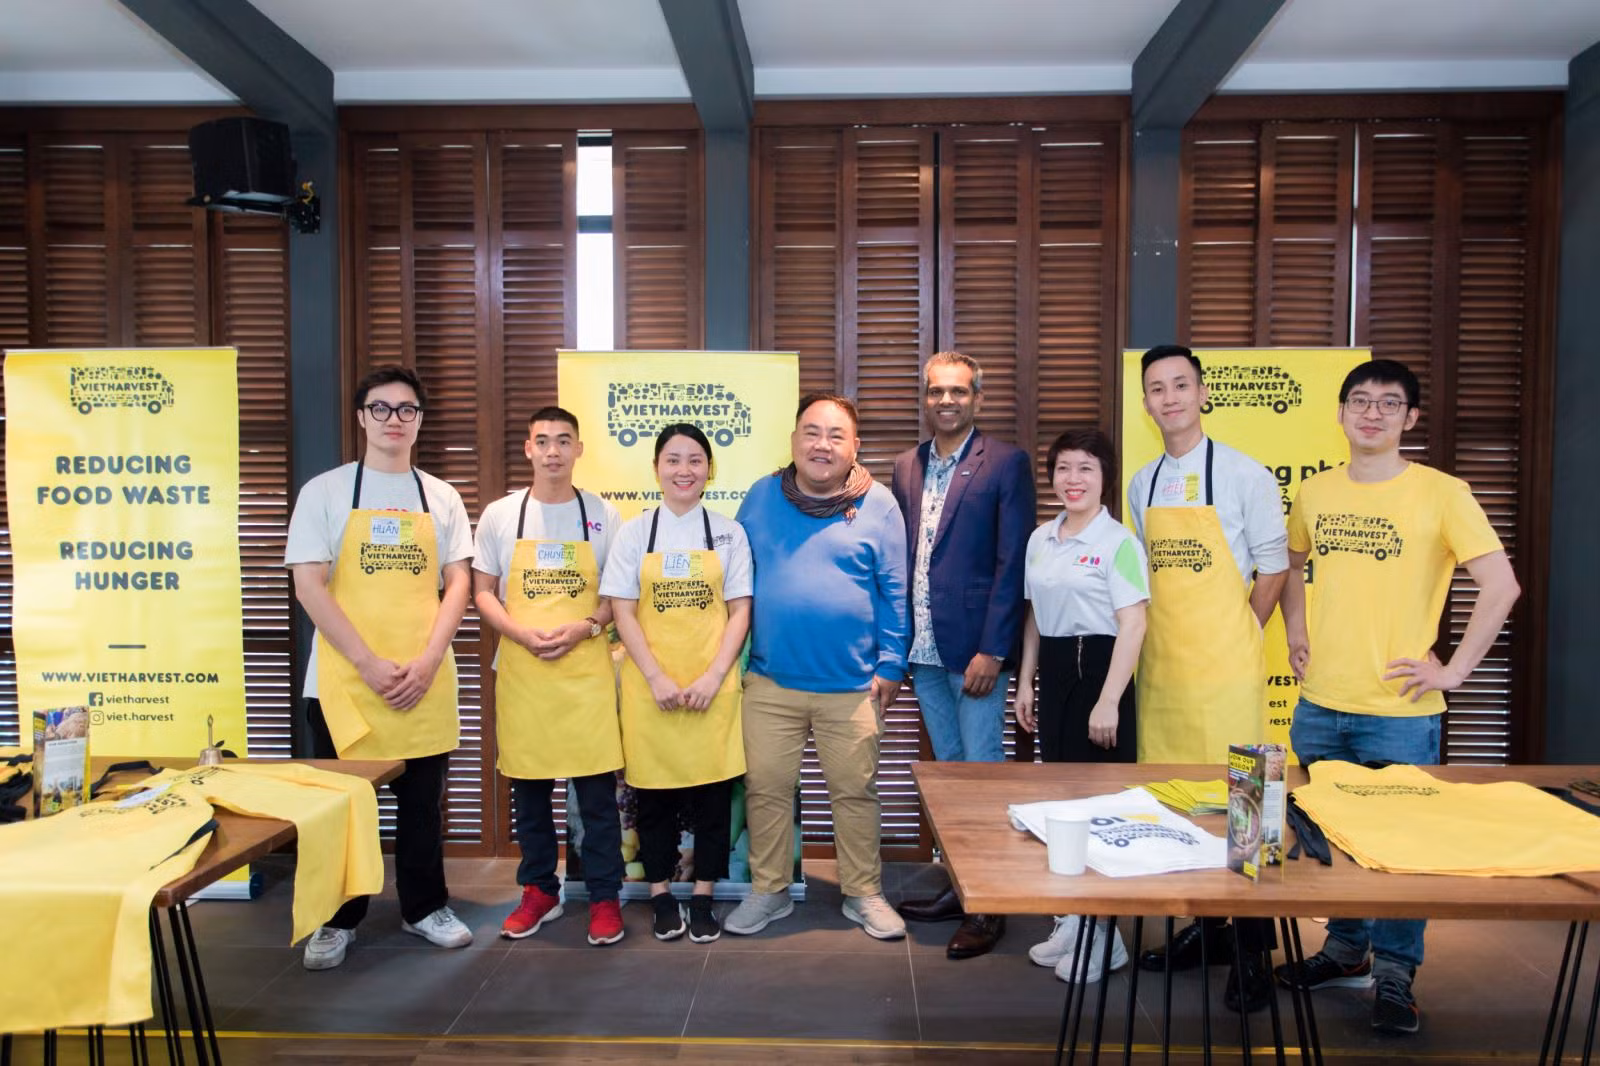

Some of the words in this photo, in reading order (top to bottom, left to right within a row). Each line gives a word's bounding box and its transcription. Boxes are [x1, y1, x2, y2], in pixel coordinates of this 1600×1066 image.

[81, 382, 159, 391] VIETHARVEST
[621, 404, 731, 416] VIETHARVEST
[56, 455, 192, 474] REDUCING
[37, 486, 113, 505] FOOD
[122, 486, 211, 504] WASTE
[1322, 528, 1388, 540] VIETHARVEST
[60, 541, 194, 560] REDUCING
[367, 553, 421, 561] VIETHARVEST
[74, 571, 181, 590] HUNGER
[657, 589, 707, 598] VIETHARVEST
[41, 671, 220, 684] WWW.VIETHARVEST.COM
[105, 695, 170, 705] vietharvest
[106, 713, 175, 723] viet.harvest
